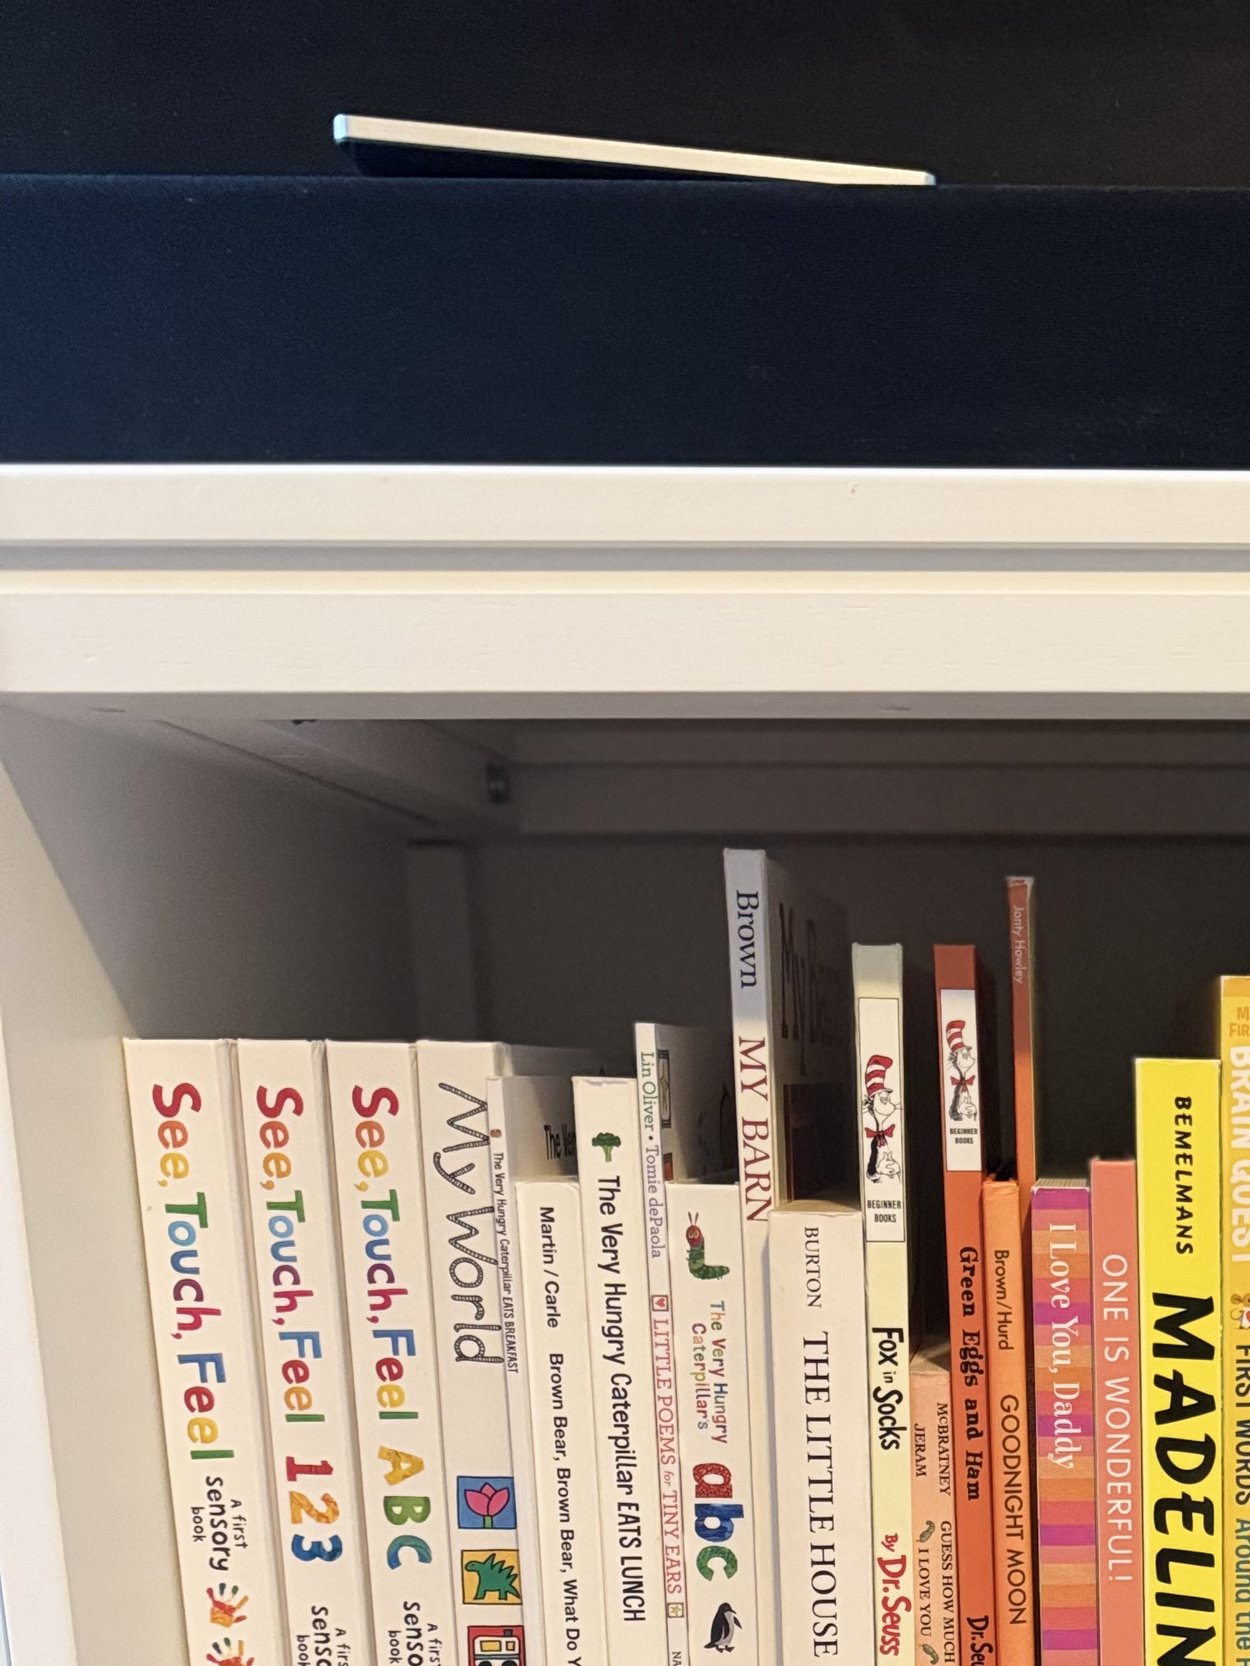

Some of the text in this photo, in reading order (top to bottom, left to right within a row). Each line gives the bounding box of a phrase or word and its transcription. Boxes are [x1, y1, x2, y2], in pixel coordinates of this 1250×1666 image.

[736, 891, 759, 988] Brown
[1013, 905, 1027, 984] Jonty Howley
[738, 1037, 768, 1101] MY
[742, 1118, 772, 1222] BARN
[867, 1199, 901, 1209] BEGINNER
[874, 1213, 896, 1223] BOOKS
[1174, 1096, 1194, 1254] BEMELMANS
[153, 1083, 235, 1460] See, Touch, Feel
[434, 1083, 503, 1364] My World
[493, 1153, 518, 1373] The Very Hungry Caterpillar EATS BREAKFAST
[549, 1353, 566, 1410] Brown
[872, 1327, 907, 1450] Fox in Socks
[960, 1246, 984, 1500] Green Eggs and Ham
[1048, 1223, 1082, 1469] I Love You, Daddy
[551, 1416, 567, 1461] Bear,
[653, 1318, 682, 1593] LITTLE POEMS for TINY EARS
[803, 1226, 839, 1657] BURTON THE LITTLE HOUSE
[1102, 1255, 1133, 1581] ONE IS WONDERFUL!
[190, 1506, 206, 1542] book
[205, 1476, 232, 1571] sensory
[556, 1468, 573, 1522] Brown
[1000, 1394, 1027, 1624] GOODNIGHT MOON
[559, 1529, 577, 1573] Bear,
[563, 1579, 580, 1623] What
[941, 1521, 955, 1663] GUESS HOW MUCH
[566, 1628, 582, 1650] Do
